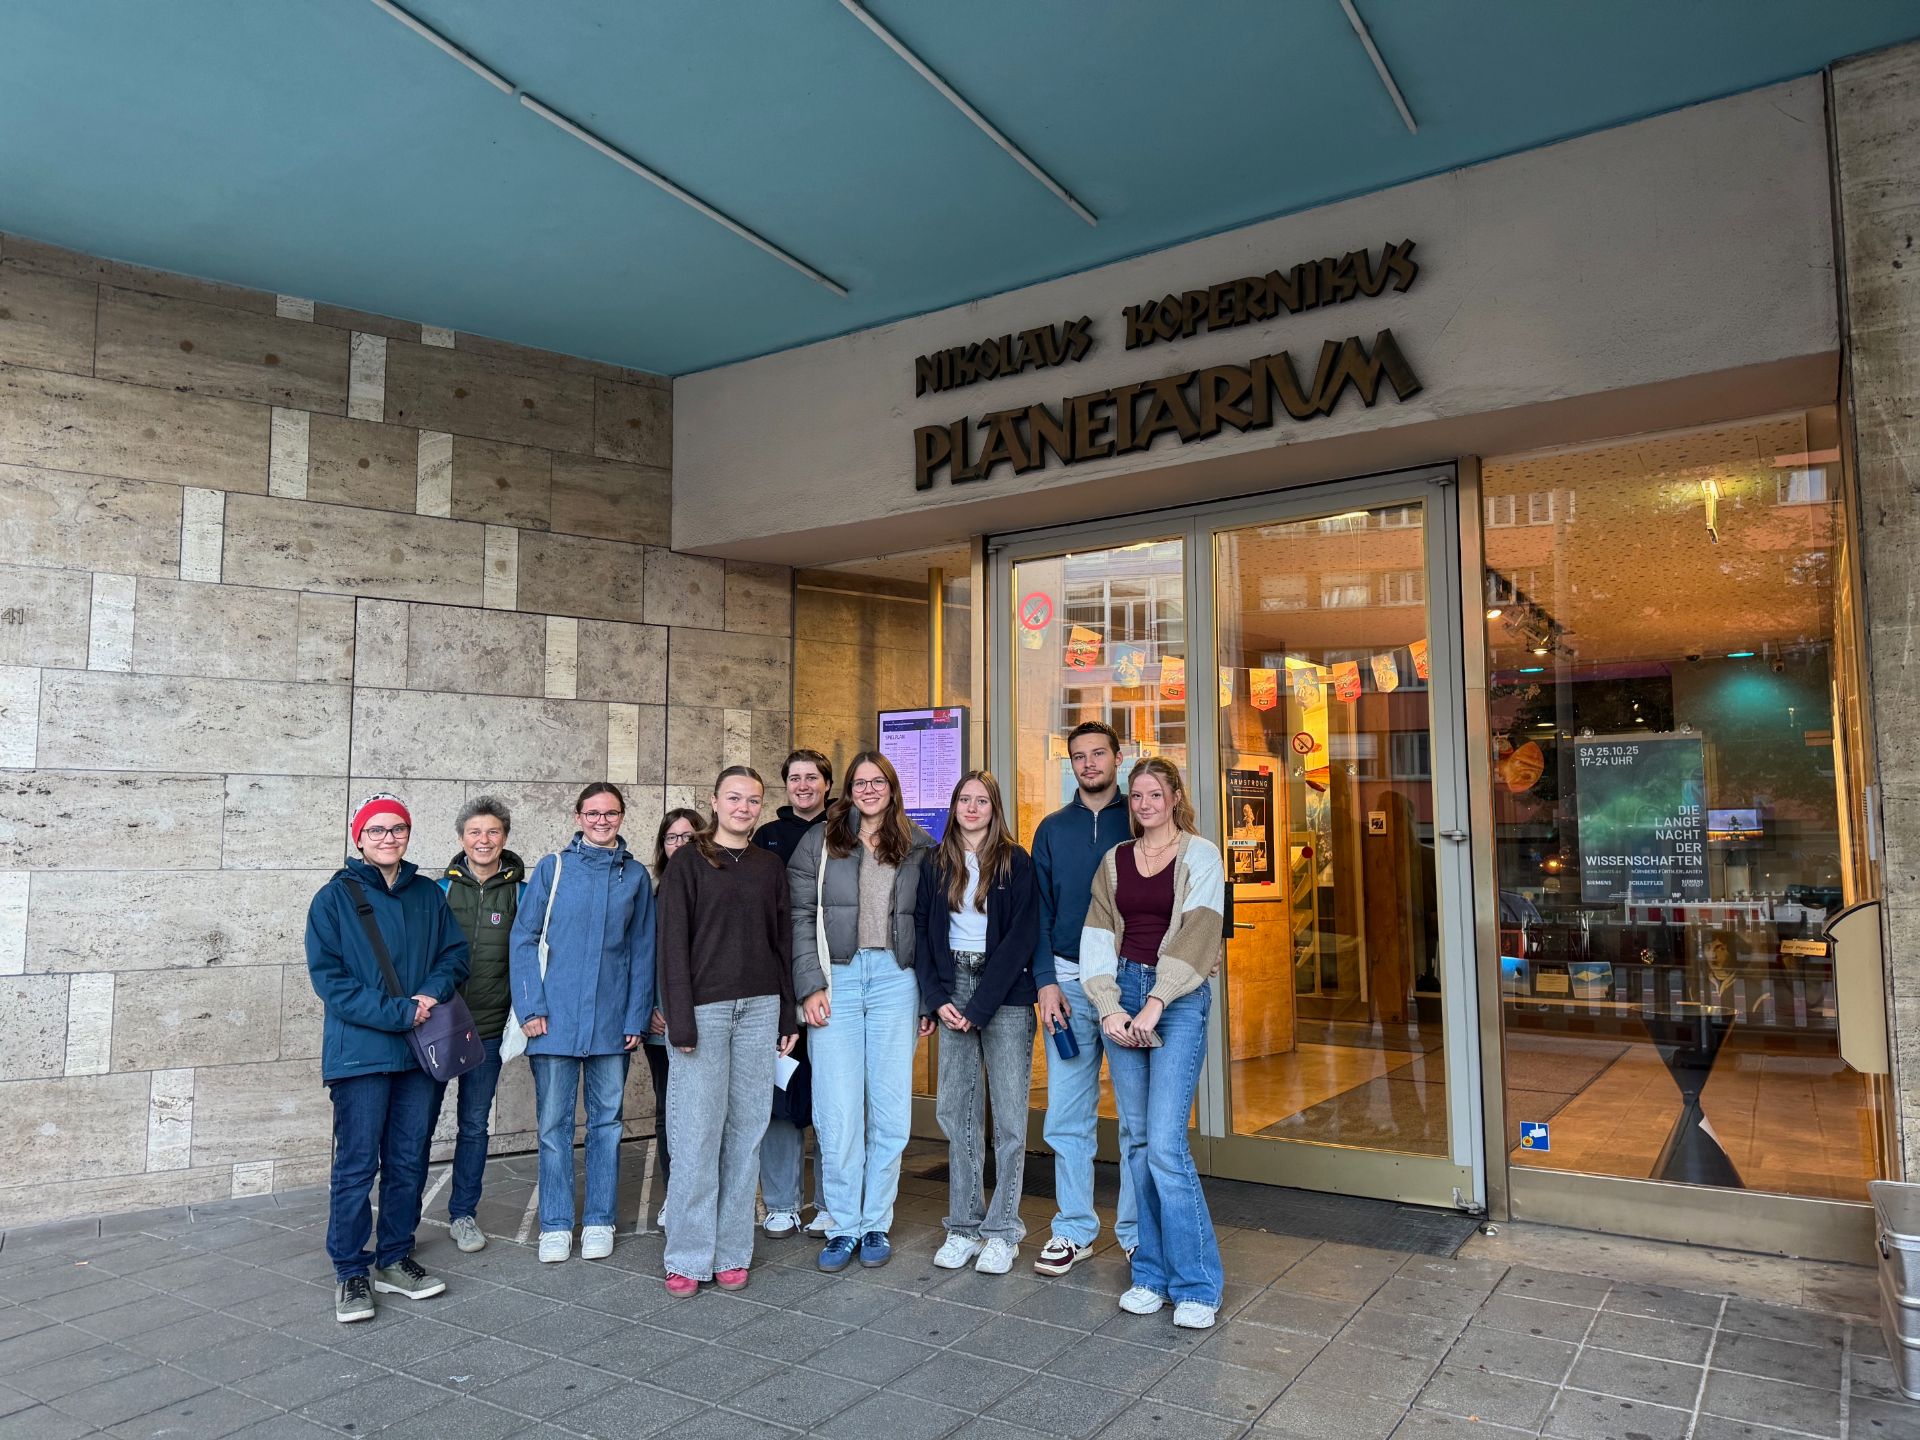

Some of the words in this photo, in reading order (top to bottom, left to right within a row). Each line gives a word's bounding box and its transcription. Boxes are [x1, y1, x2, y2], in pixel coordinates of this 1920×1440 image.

[915, 315, 1093, 398] NIKOLAUS
[1123, 238, 1419, 350] KOPERNIKUS
[913, 328, 1423, 491] PLANETARIUM
[1, 607, 24, 625] 41
[1580, 747, 1594, 757] SA
[1597, 746, 1639, 756] 25.10.25
[1580, 757, 1608, 767] 17-24
[1611, 756, 1633, 766] UHR
[1230, 779, 1268, 787] ARMSTRONG
[1678, 805, 1700, 815] DIE
[1655, 817, 1701, 828] LANGE
[1655, 829, 1701, 840] NACHT
[1676, 842, 1702, 853] DER
[1586, 855, 1702, 866] WISSENSCHAFTEN
